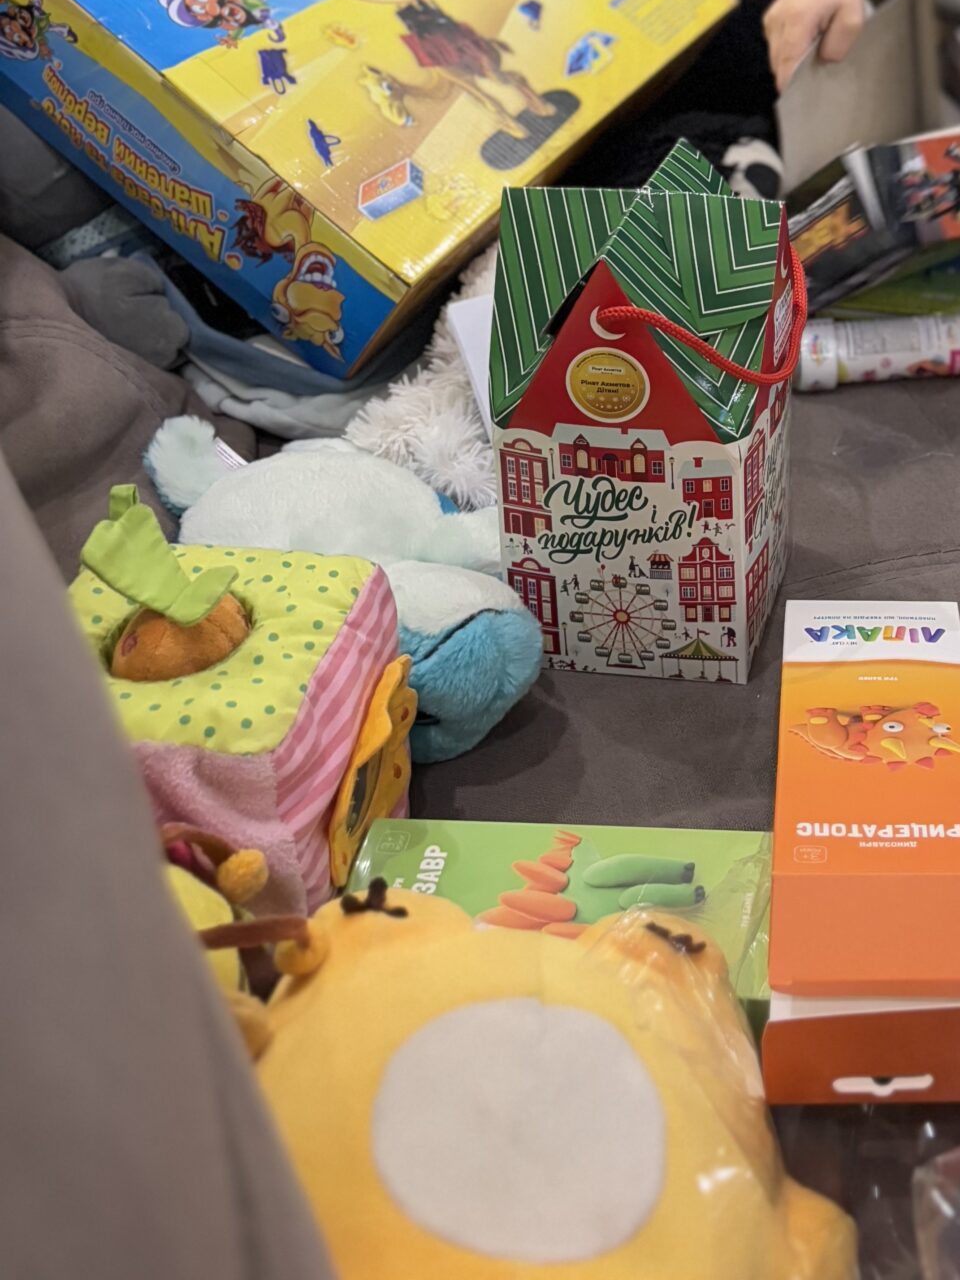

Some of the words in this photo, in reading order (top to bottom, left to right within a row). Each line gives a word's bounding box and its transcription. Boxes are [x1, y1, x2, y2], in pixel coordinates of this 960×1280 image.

[43, 65, 112, 146] верблюд
[111, 166, 226, 263] Алі-баба
[543, 476, 649, 529] Чудес
[651, 504, 657, 524] і
[537, 504, 697, 565] подарунків!
[804, 624, 946, 643] ЛІПАКА
[411, 844, 448, 894] ЗАВР
